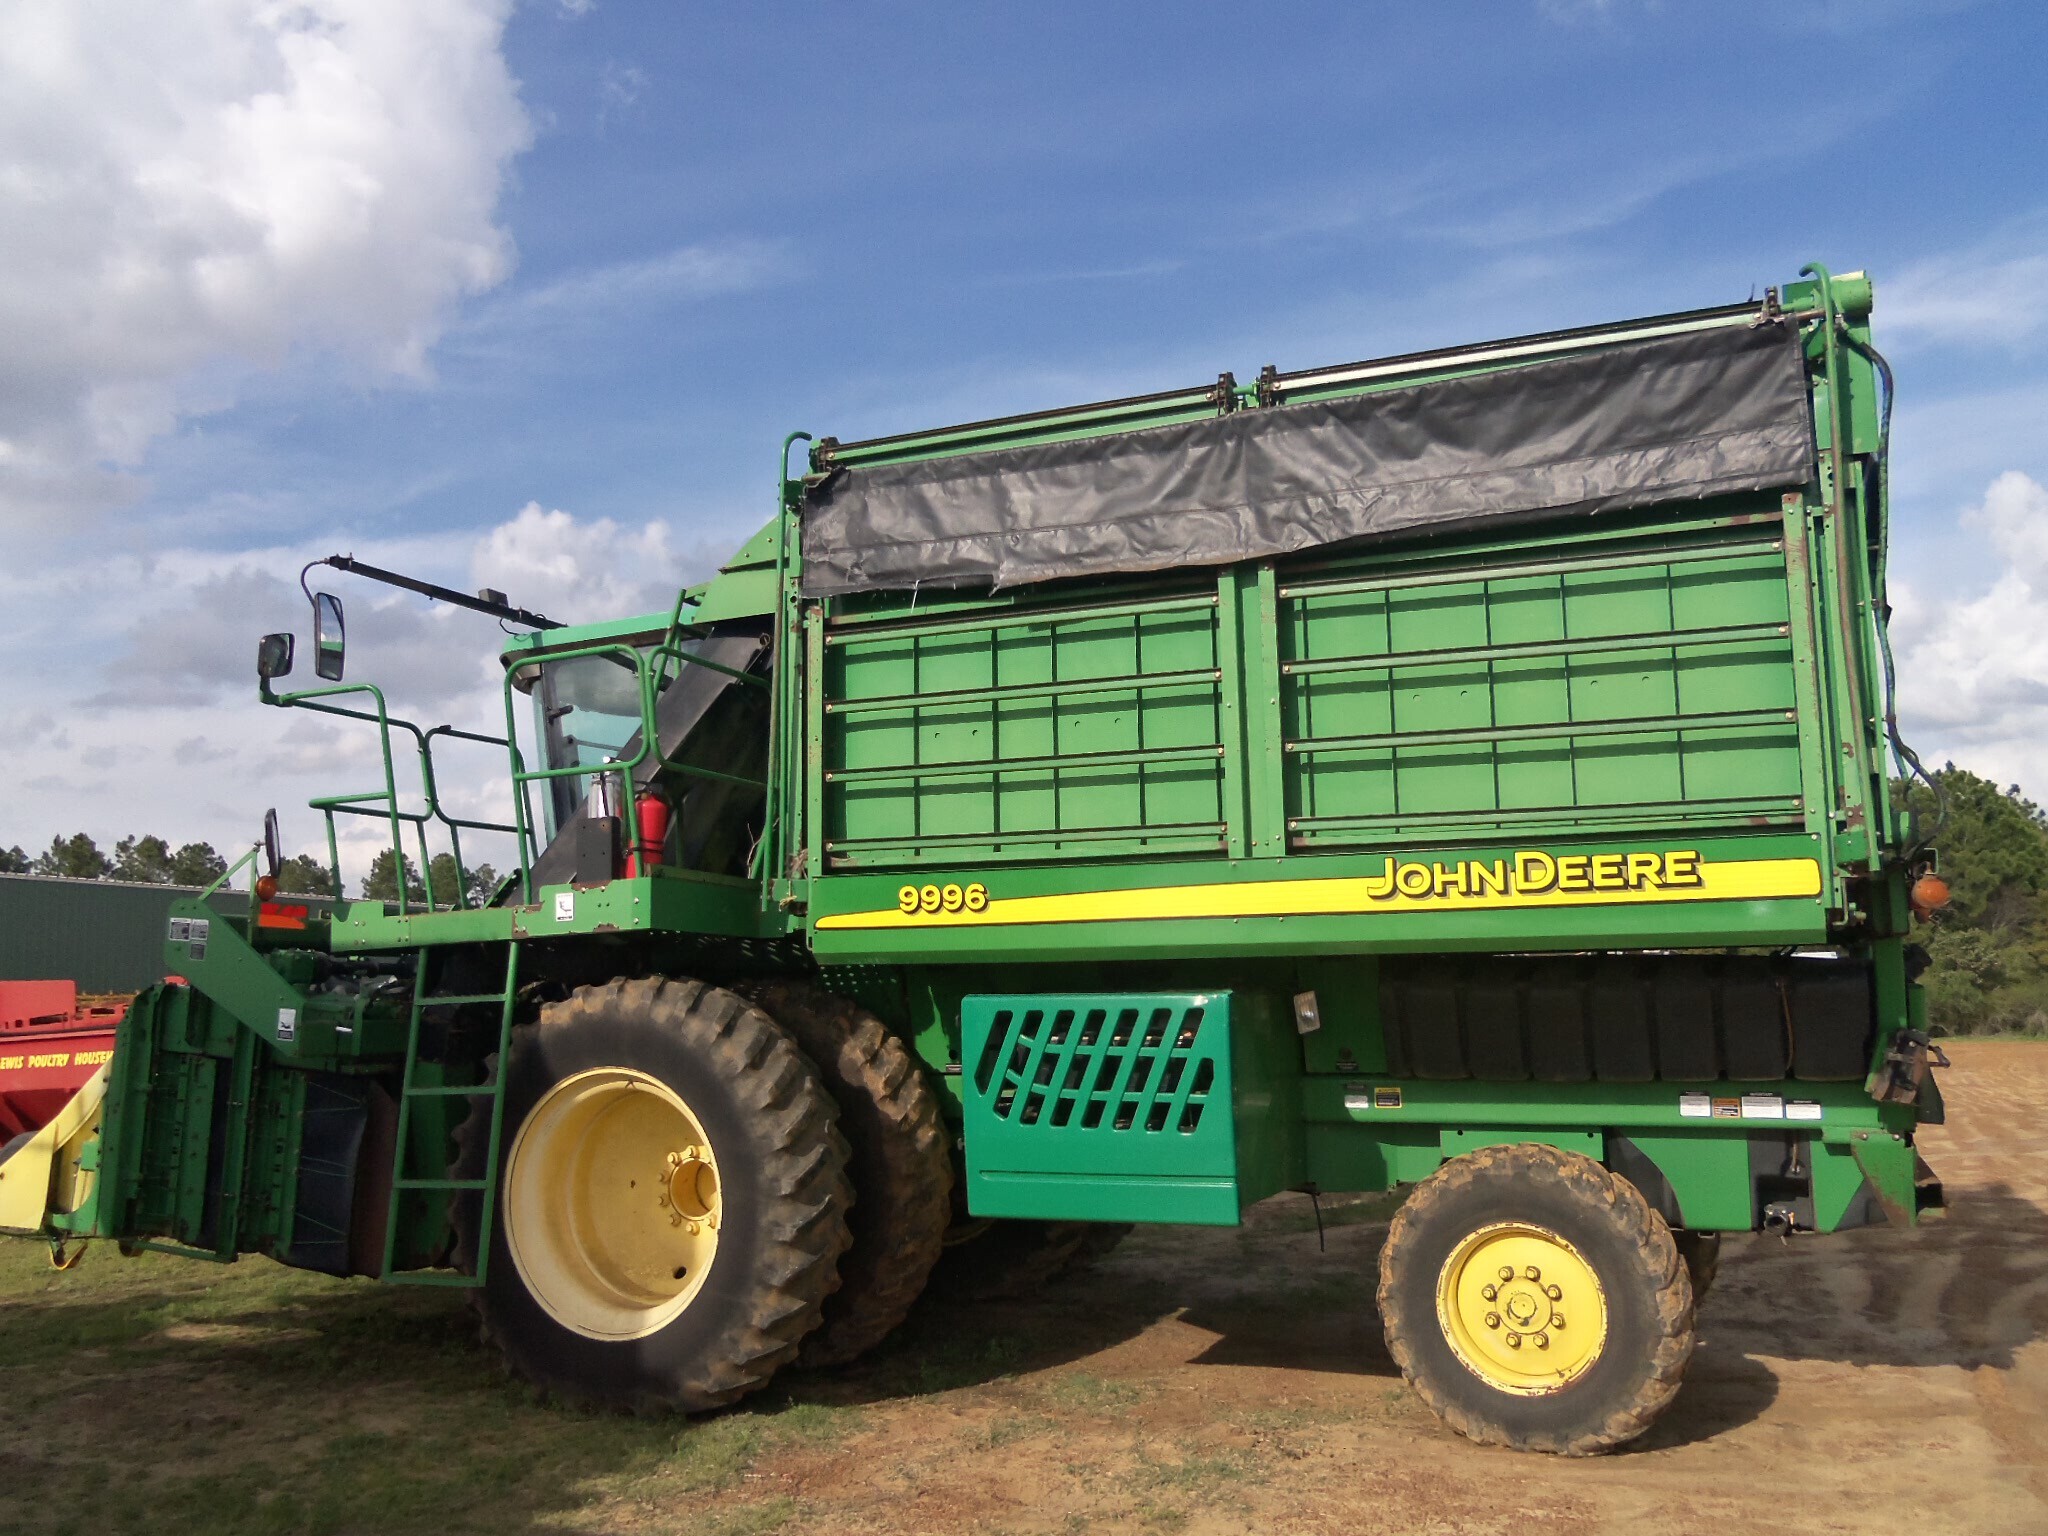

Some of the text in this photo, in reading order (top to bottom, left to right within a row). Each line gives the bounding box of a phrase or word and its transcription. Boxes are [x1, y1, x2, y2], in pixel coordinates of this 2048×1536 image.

[1367, 850, 1702, 899] JOHN DEERE
[899, 883, 990, 914] 9996
[0, 1056, 24, 1070] EWIS
[28, 1053, 70, 1068] POULTRY
